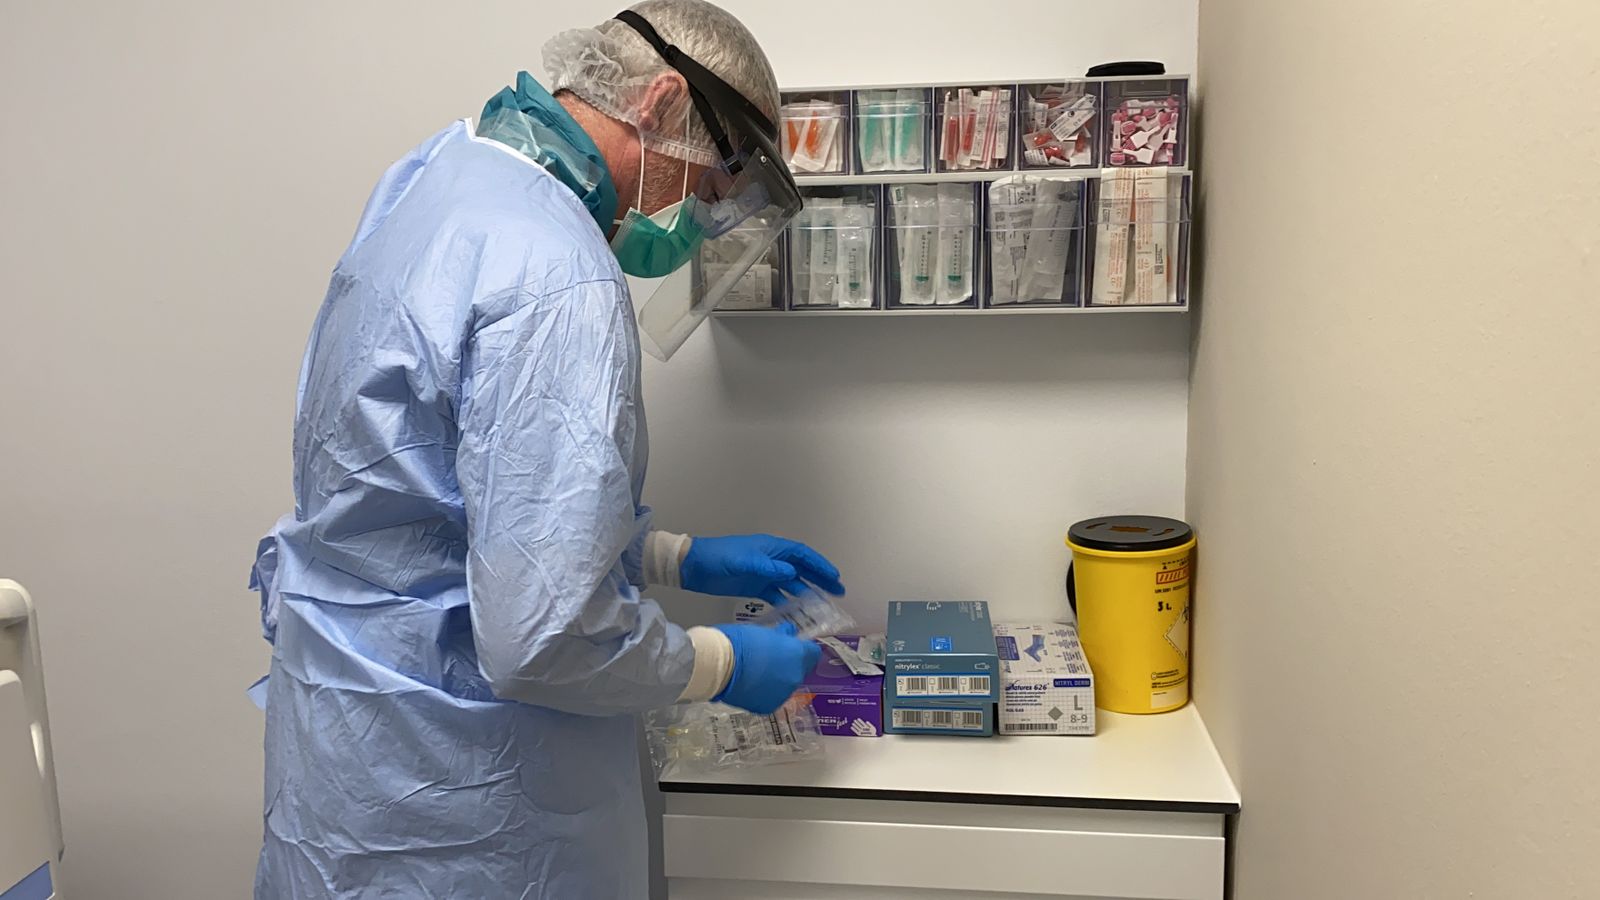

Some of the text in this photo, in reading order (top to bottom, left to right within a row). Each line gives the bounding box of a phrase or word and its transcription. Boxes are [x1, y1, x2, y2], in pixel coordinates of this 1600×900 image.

[895, 663, 920, 671] nitrylex
[1073, 695, 1084, 711] L
[1070, 714, 1088, 724] 8-9
